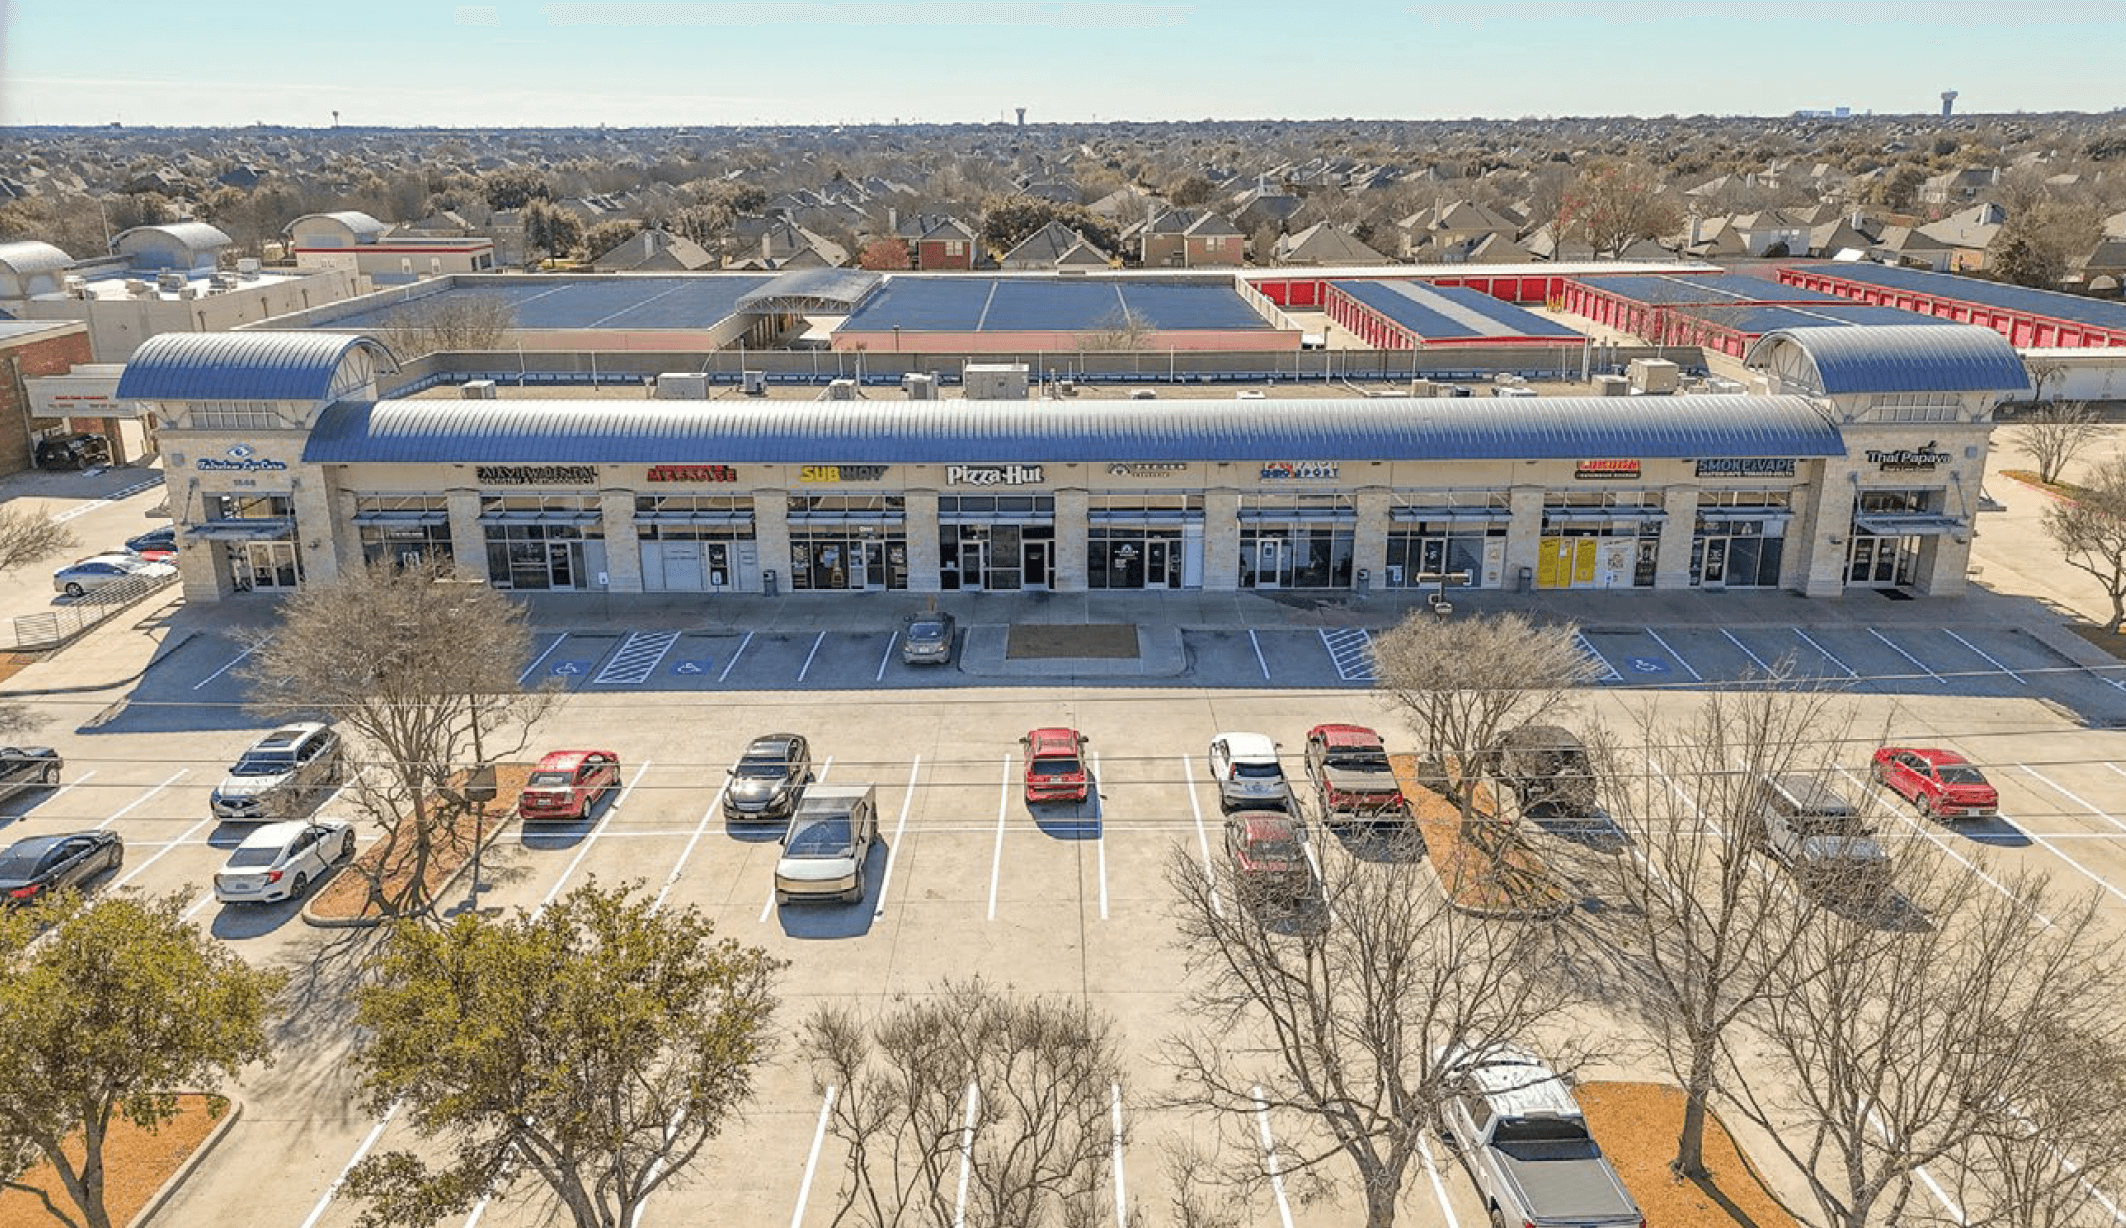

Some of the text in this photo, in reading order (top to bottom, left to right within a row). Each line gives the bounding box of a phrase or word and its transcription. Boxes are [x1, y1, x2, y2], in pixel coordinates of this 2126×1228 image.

[800, 465, 887, 482] SUBWAY
[947, 464, 1044, 485] Pizza Hut
